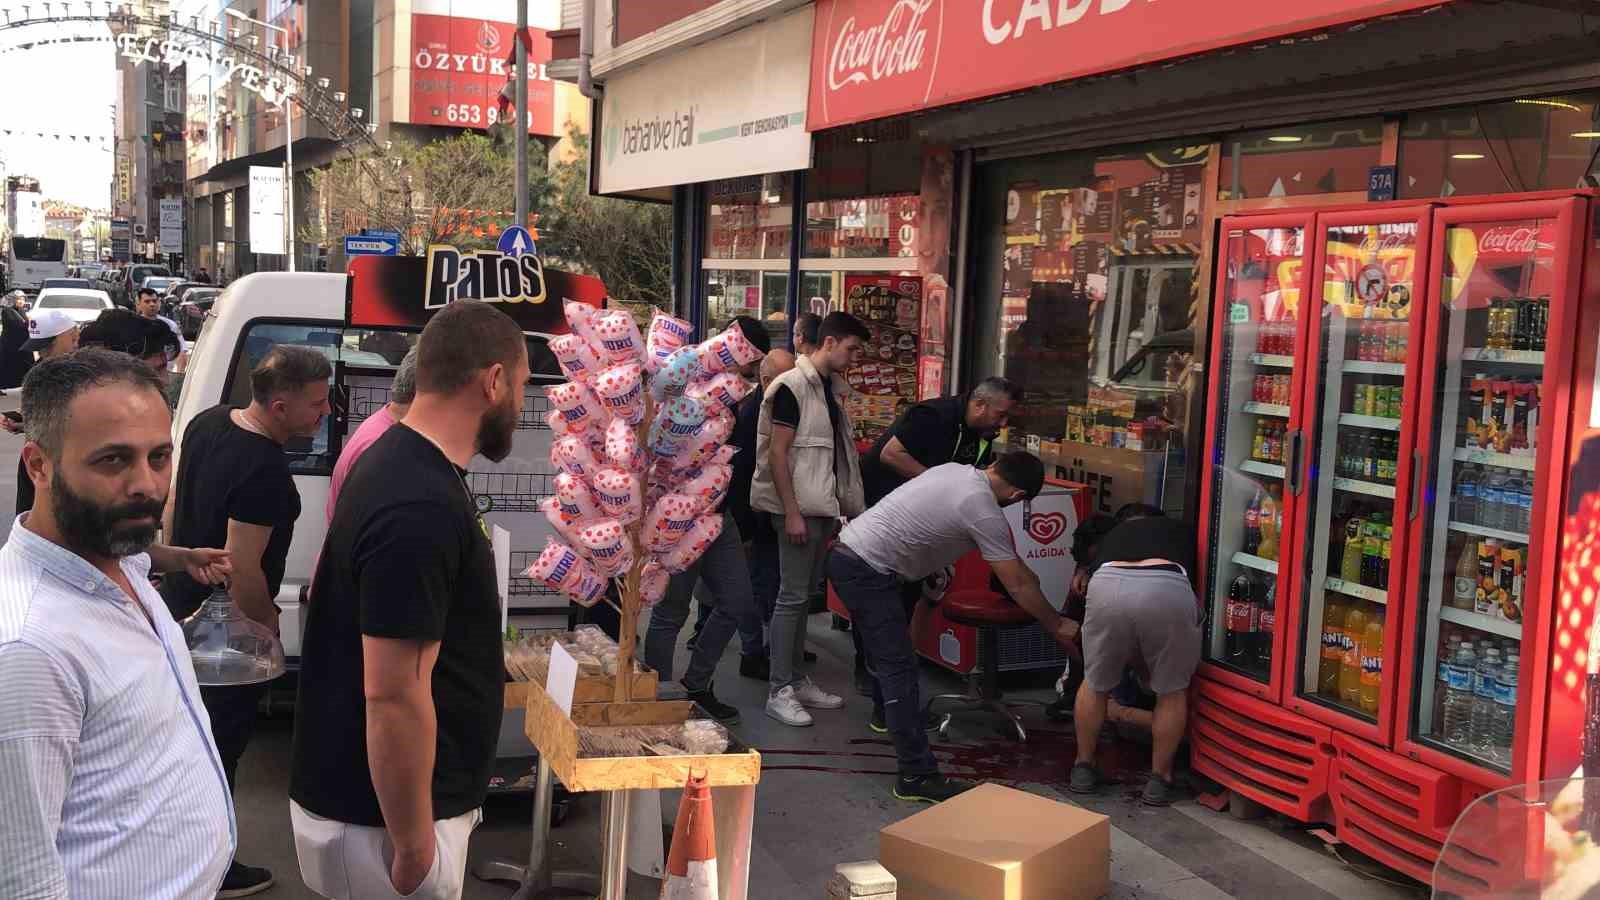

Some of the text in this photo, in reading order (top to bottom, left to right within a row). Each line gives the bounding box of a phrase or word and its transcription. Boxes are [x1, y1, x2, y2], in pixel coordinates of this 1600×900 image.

[829, 0, 932, 91] Coca-Cola
[447, 104, 480, 123] 653
[1026, 548, 1065, 559] ALGIDA
